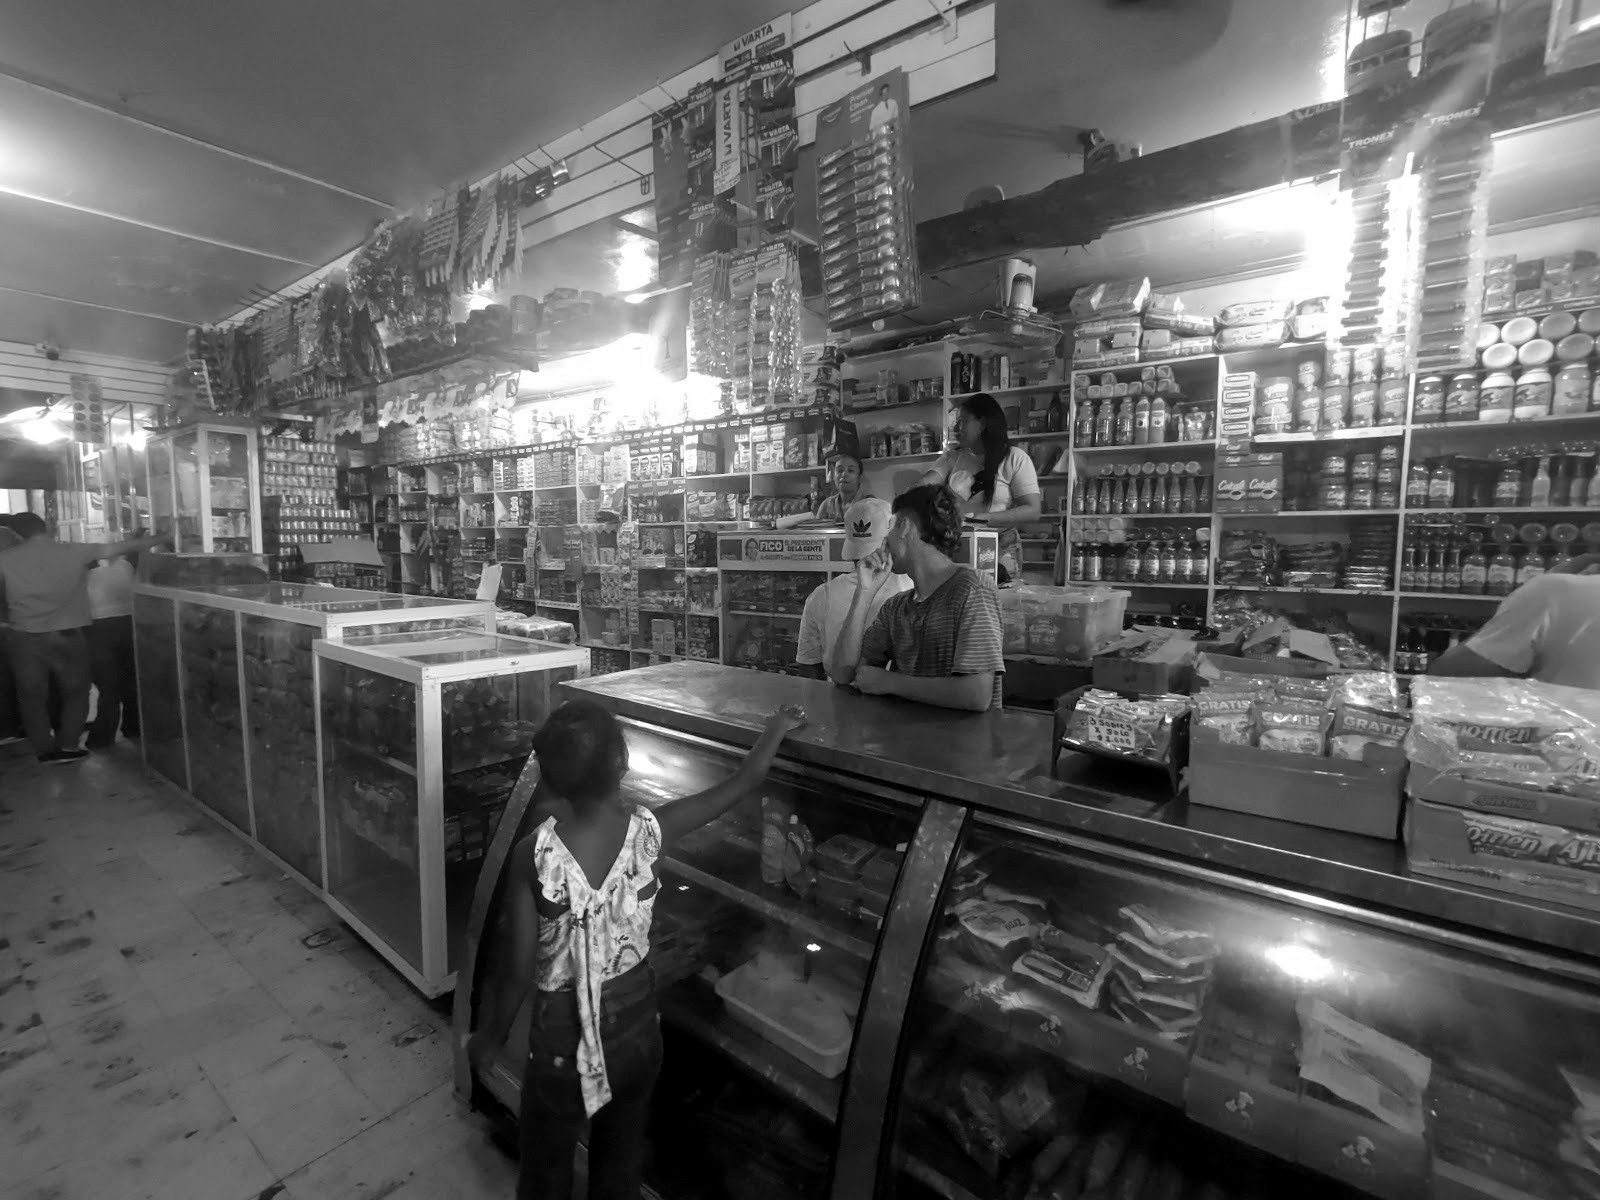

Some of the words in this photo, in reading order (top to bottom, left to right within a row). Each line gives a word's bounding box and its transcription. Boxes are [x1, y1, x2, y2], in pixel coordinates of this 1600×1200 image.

[741, 24, 773, 47] VARTA
[760, 59, 784, 71] VARTA
[695, 87, 712, 100] VARTA
[723, 90, 732, 143] VARTA
[1430, 107, 1480, 124] TRONEX
[768, 124, 790, 137] VARTA
[1349, 130, 1394, 149] TRONEX
[764, 180, 784, 193] VARTA
[766, 242, 785, 252] VARTA
[737, 256, 756, 266] VARTA
[760, 541, 783, 551] FICO
[1200, 701, 1250, 711] GRATIS
[1089, 717, 1096, 725] 3
[1262, 711, 1320, 726] GRATIS
[1343, 716, 1407, 737] GRATIS
